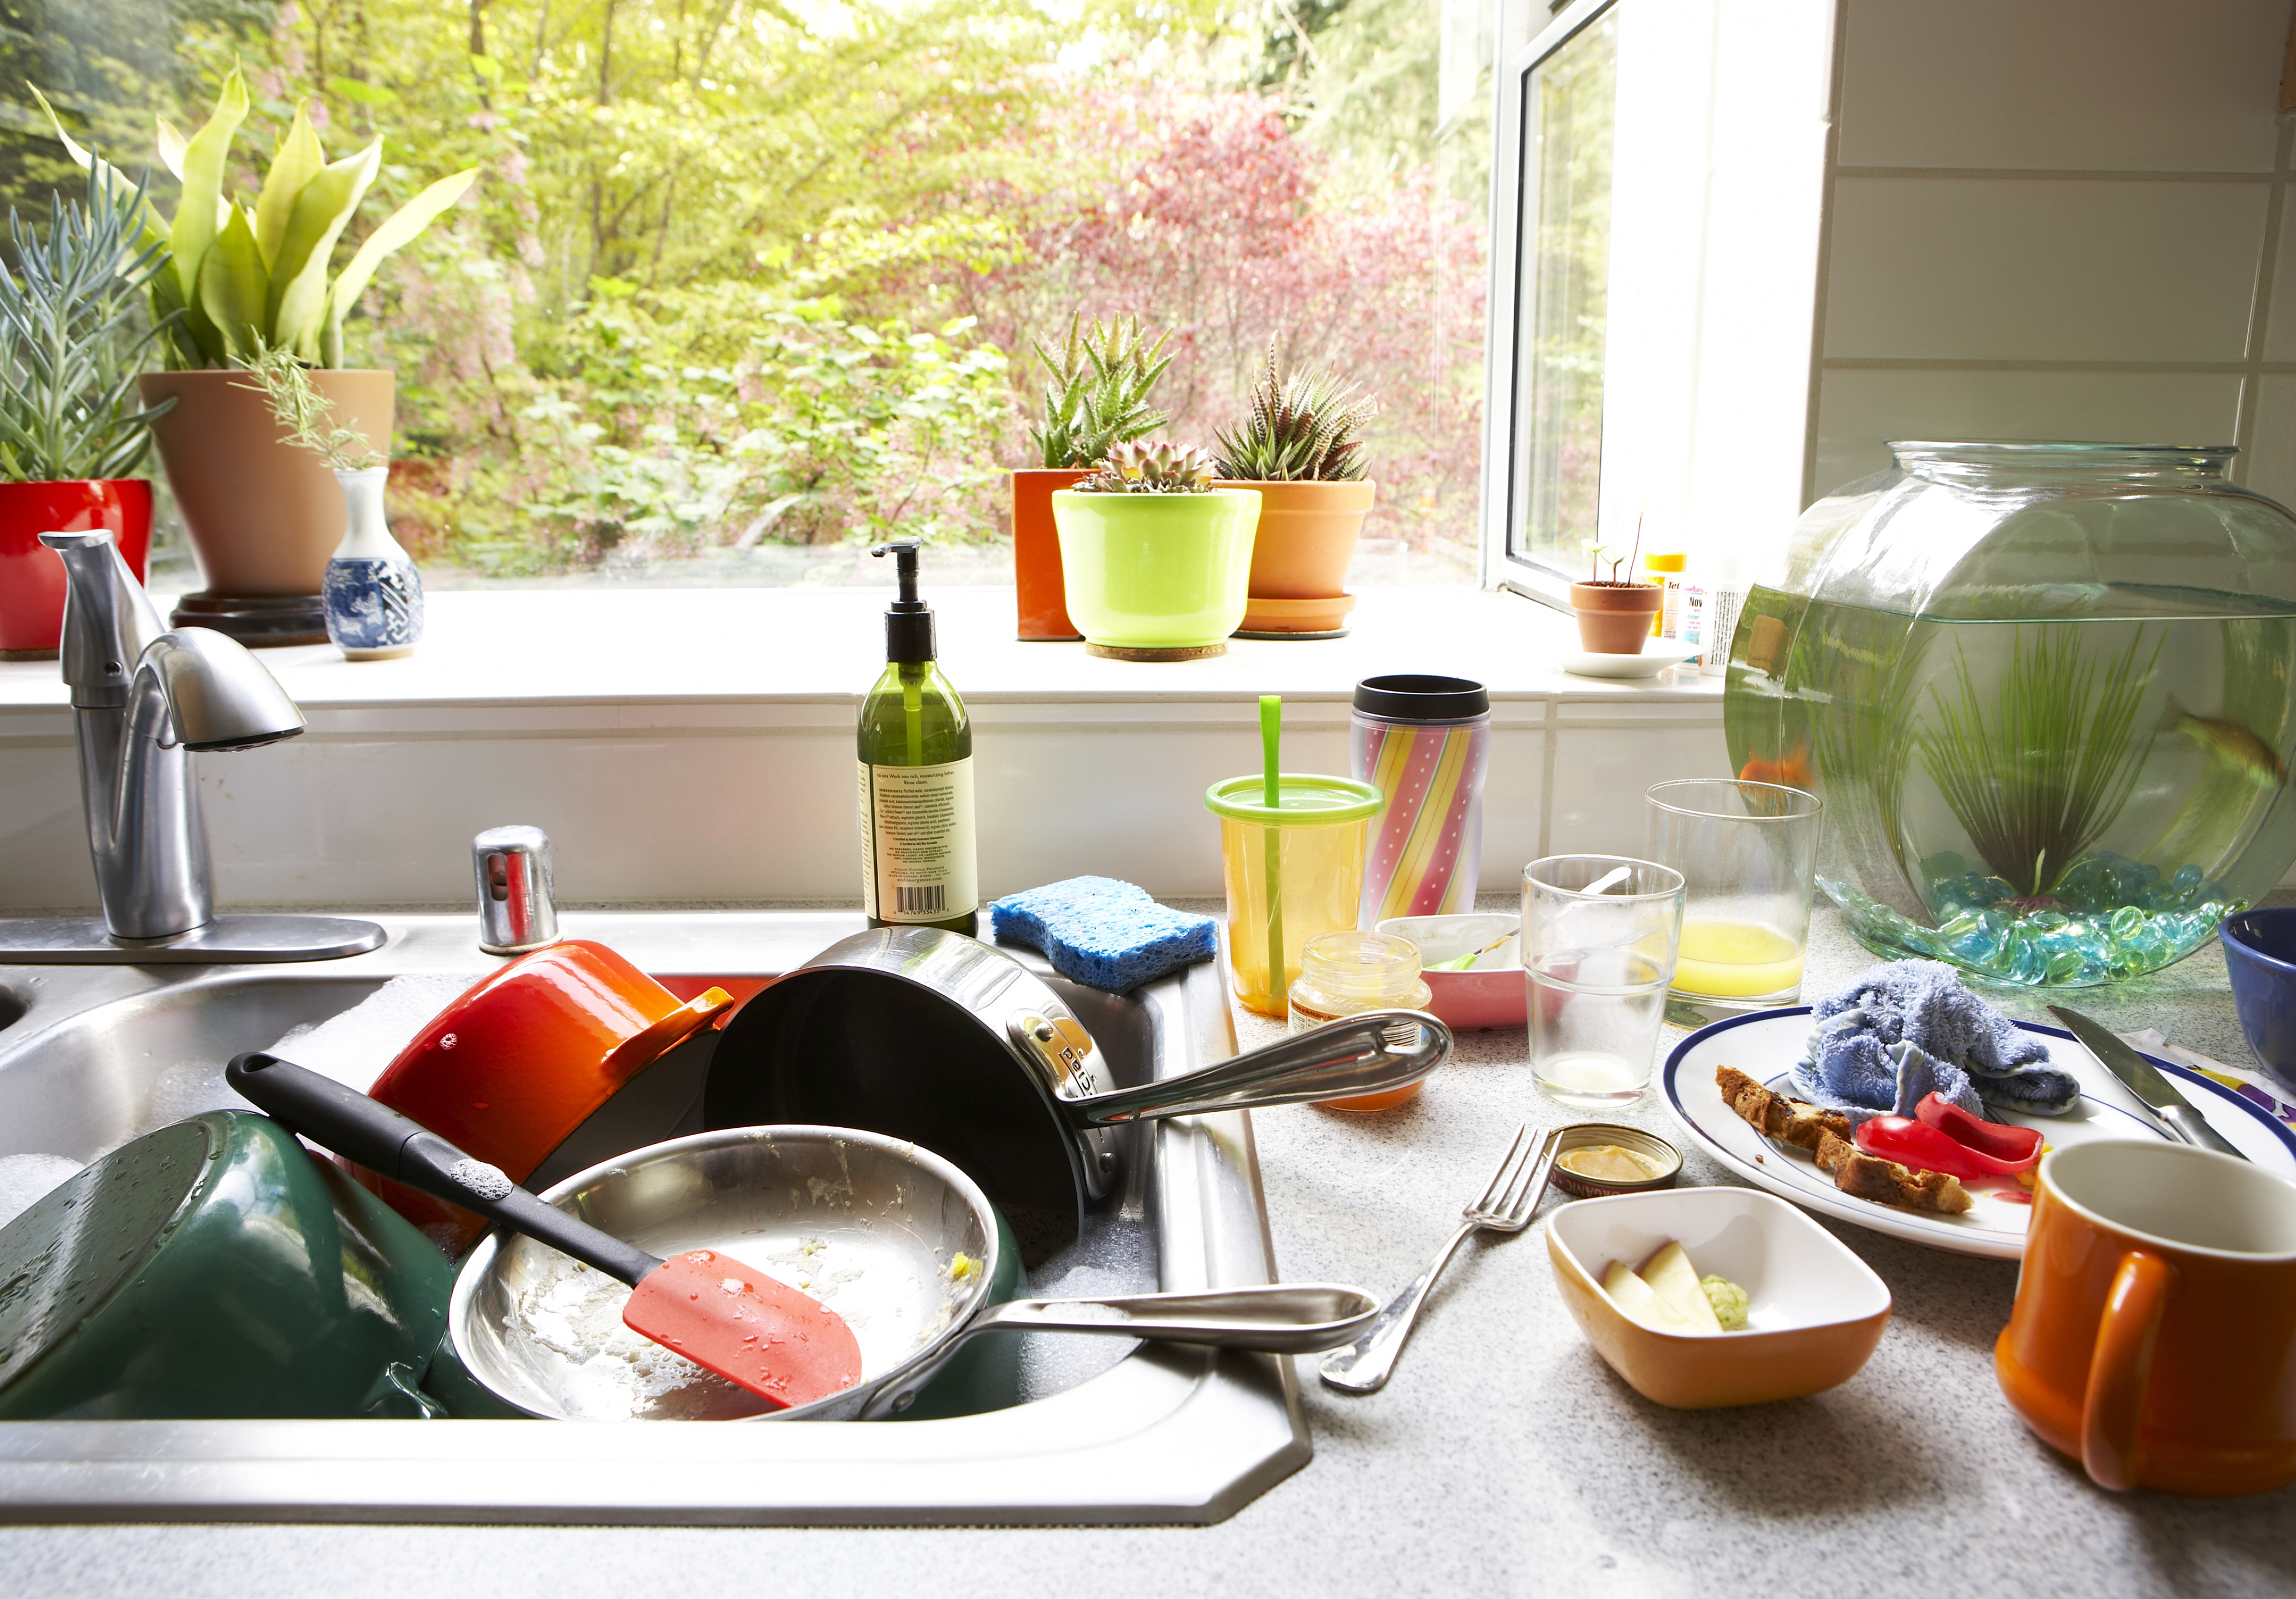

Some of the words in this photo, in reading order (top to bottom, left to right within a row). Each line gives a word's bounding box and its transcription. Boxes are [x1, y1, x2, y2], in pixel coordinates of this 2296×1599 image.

[1668, 581, 1680, 589] Tet
[1689, 597, 1702, 607] Nov
[1305, 1009, 1324, 1019] Herbicides
[1061, 1046, 1091, 1092] Clad
